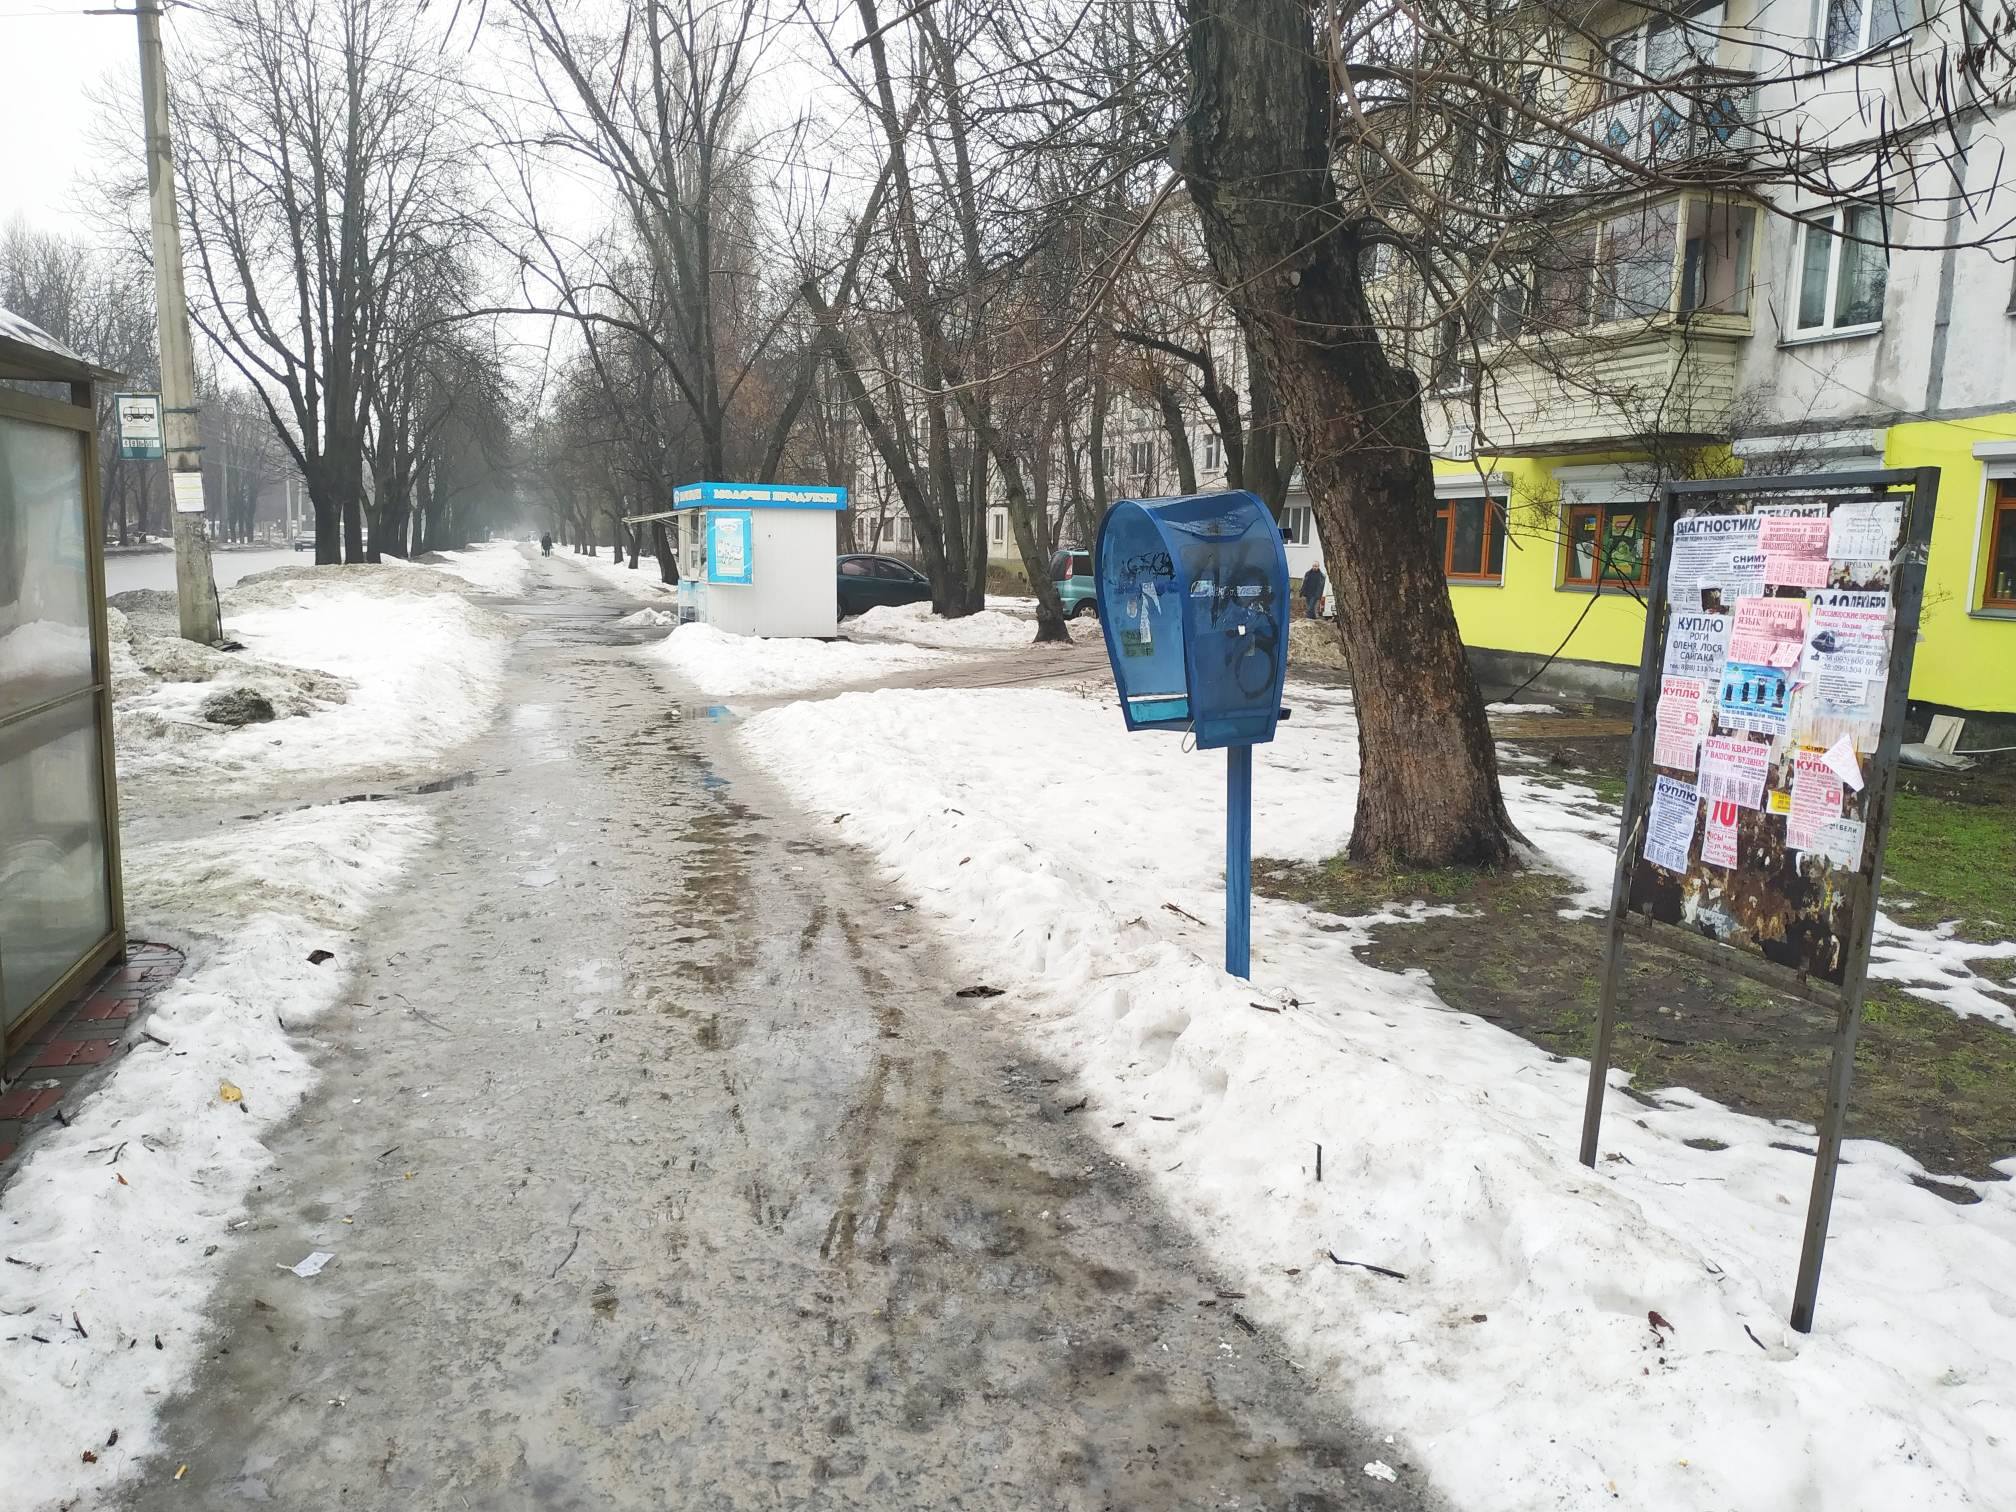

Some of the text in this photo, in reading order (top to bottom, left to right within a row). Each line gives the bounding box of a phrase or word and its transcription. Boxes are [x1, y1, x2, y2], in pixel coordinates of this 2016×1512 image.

[1733, 554, 1767, 563] СНИМУ
[1739, 607, 1796, 620] АНГЛИЙСКИЙ
[1677, 616, 1724, 633] КУПЛЮ
[1738, 617, 1761, 626] ЯЗЫК
[1689, 632, 1709, 641] РОГИ
[1700, 643, 1724, 655] ЛОСЯ,
[1680, 651, 1714, 662] САЙГАКА
[1663, 687, 1700, 700] КУПЛЮ
[1706, 739, 1769, 757] КУПЛЮ КВАРТИРУ
[1796, 760, 1834, 774] КУПЛ
[1658, 783, 1698, 802] КУПЛЮ
